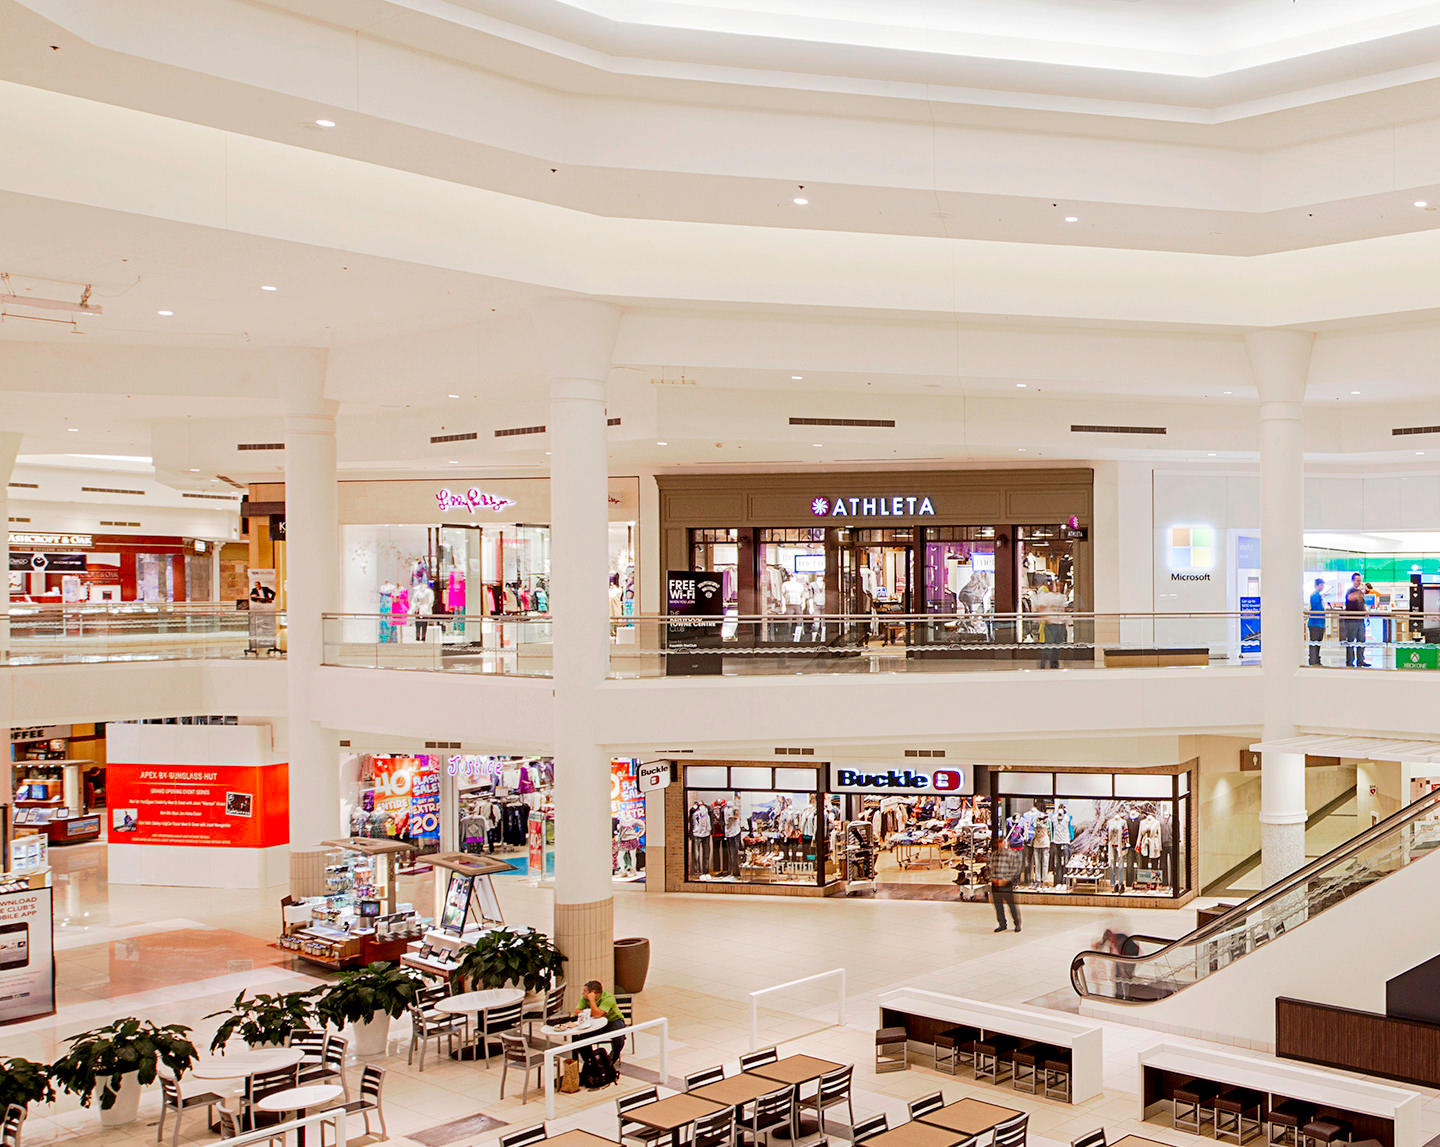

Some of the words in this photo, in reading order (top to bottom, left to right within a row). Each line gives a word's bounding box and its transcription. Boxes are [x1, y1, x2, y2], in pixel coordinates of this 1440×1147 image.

[832, 497, 935, 516] ATHLETA
[1171, 573, 1211, 581] Microsoft
[669, 580, 696, 590] FREE
[669, 590, 696, 600] Wi-Fi
[448, 754, 503, 776] Justice
[140, 771, 157, 779] APEX
[203, 773, 217, 781] HUT
[641, 765, 668, 777] Buckle
[837, 770, 928, 788] Buckle
